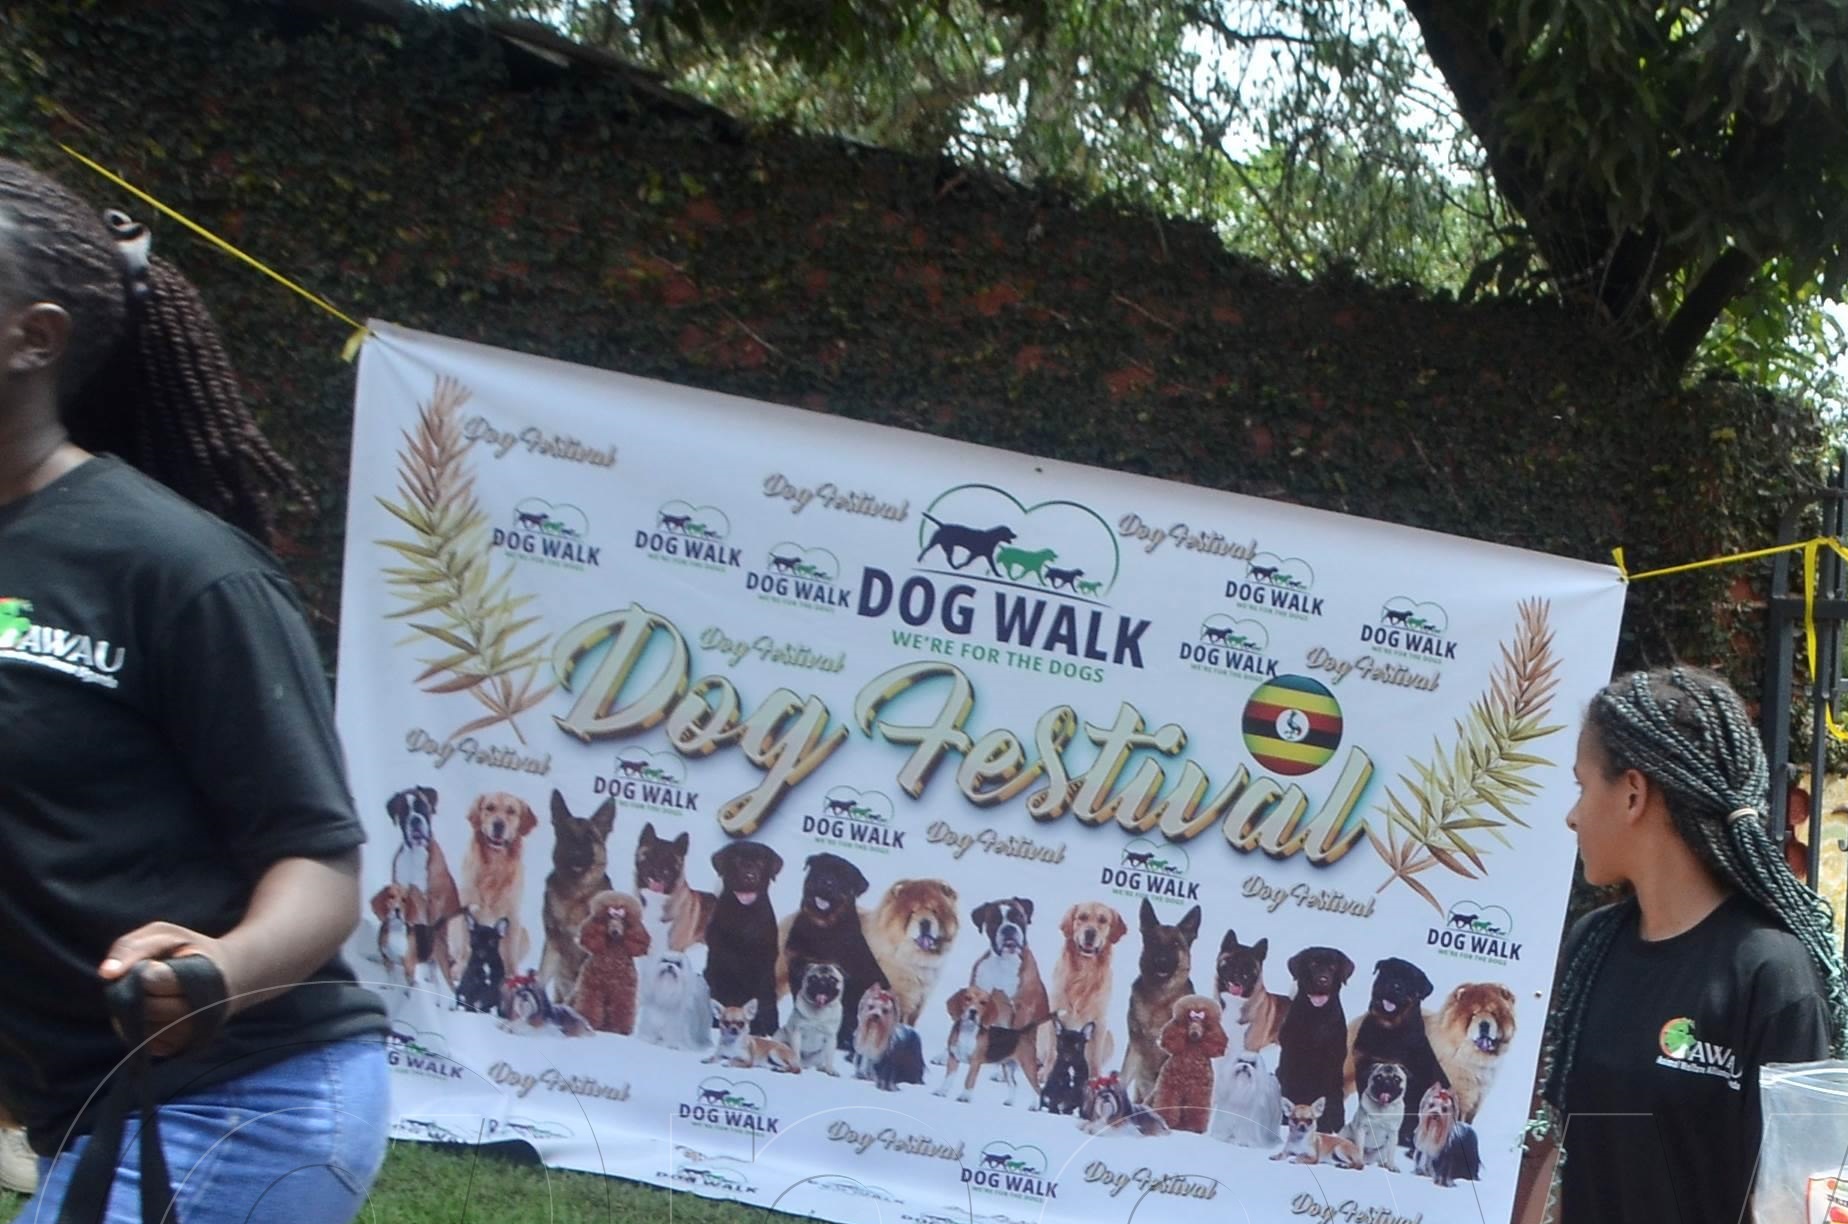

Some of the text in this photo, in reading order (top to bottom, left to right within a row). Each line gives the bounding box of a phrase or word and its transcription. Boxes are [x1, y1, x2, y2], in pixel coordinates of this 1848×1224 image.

[464, 416, 518, 459] Dog
[762, 473, 814, 514] Dog
[493, 528, 534, 553] DOG
[541, 539, 600, 566] WALK
[635, 530, 677, 555] DOG
[684, 540, 743, 567] WALK
[1118, 512, 1166, 554] Dog
[746, 572, 788, 596] DOG
[795, 583, 852, 608] WALK
[1225, 580, 1325, 617] DOG WALK
[857, 566, 1153, 669] DOG WALK
[700, 626, 750, 667] Dog
[892, 629, 1105, 683] WE'RE FOR THE DOGS
[1180, 642, 1279, 678] DOG WALK
[1360, 624, 1457, 660] DOG WALK
[1306, 648, 1352, 684] Dog
[405, 728, 457, 768] Dog
[551, 601, 1374, 867] Dog Festival
[594, 776, 635, 798] DOG
[641, 784, 698, 811] WALK
[802, 815, 850, 842] DOG
[857, 823, 906, 850] WALK
[926, 821, 975, 859] Dog
[1101, 867, 1200, 900] DOG WALK
[1241, 875, 1289, 913] Dog
[1427, 928, 1523, 961] DOG WALK
[406, 1054, 464, 1079] WALK
[488, 1061, 539, 1098] Dog
[679, 1103, 719, 1124] DOG
[725, 1110, 779, 1134] WALK
[826, 1120, 876, 1155] Dog
[960, 1167, 1059, 1199] DOG WALK
[1083, 1160, 1131, 1198] Dog
